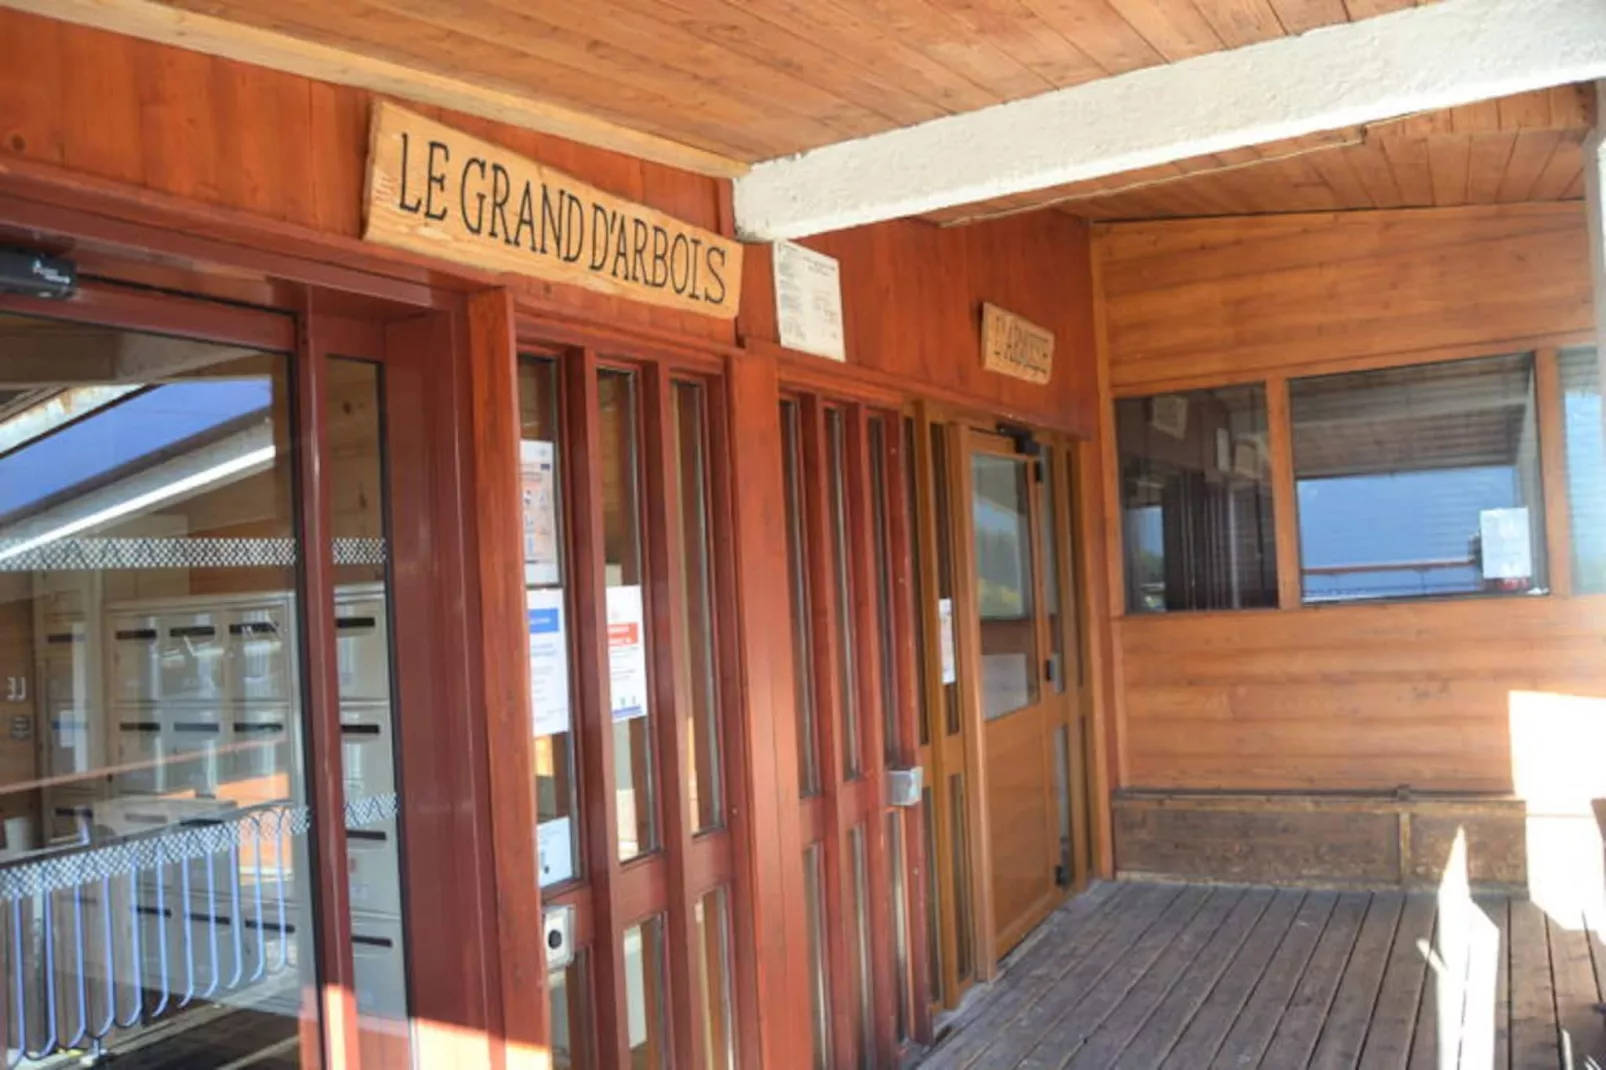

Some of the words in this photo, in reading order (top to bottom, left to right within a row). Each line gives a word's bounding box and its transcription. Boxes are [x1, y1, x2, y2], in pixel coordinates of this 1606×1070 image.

[399, 132, 450, 221] LE
[460, 157, 585, 263] GRAND
[588, 202, 726, 305] D'ARBOIS
